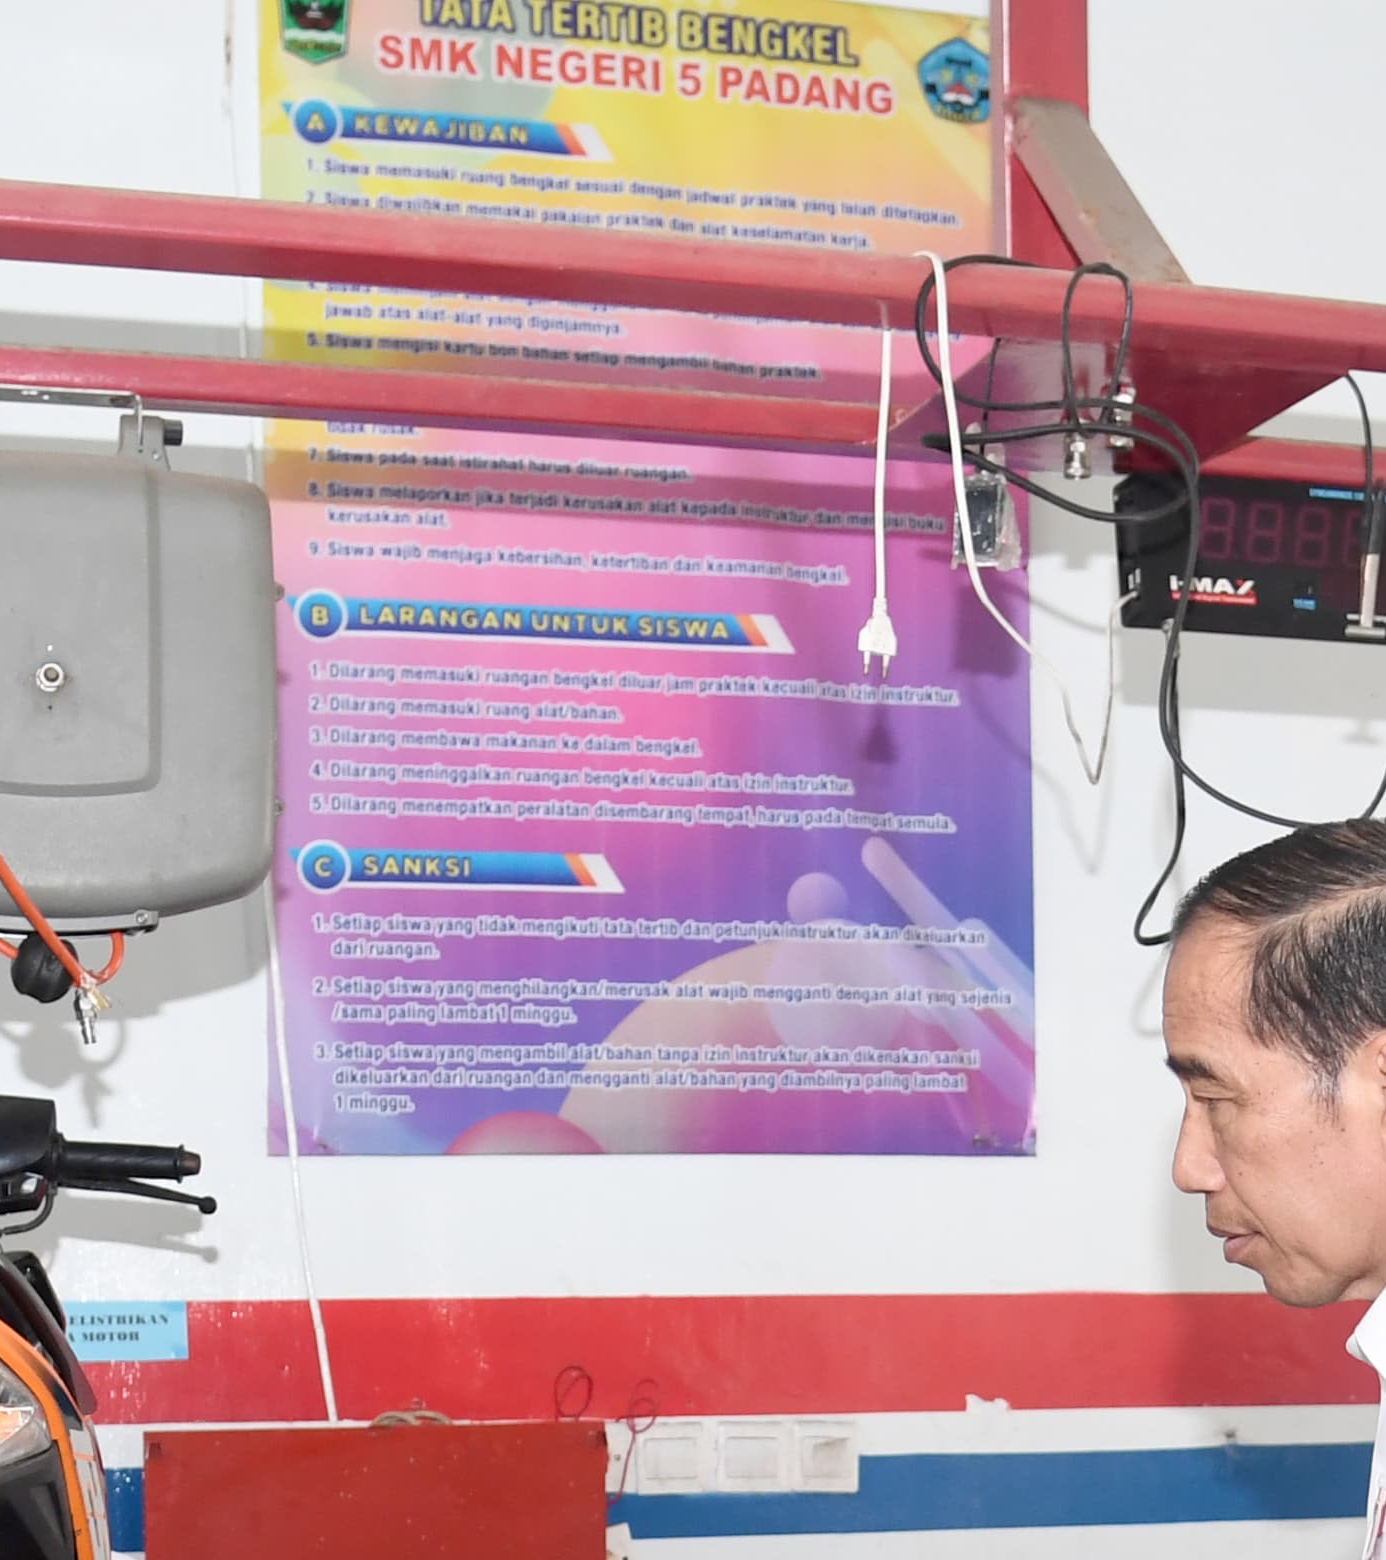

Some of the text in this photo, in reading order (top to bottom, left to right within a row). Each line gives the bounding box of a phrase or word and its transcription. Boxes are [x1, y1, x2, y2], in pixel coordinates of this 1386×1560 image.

[527, 0, 668, 47] TERTIB
[677, 10, 860, 66] BENGKEL
[379, 35, 893, 114] SMK NEGERI 5 PADANG
[307, 112, 325, 132] A
[354, 112, 530, 145] KEWAJIBAN
[310, 604, 330, 626] B
[359, 605, 731, 640] LARANGAN UNTUK SISWA
[329, 663, 395, 683] Dilarang
[402, 666, 480, 683] memasuki
[484, 672, 547, 689] ruangan
[553, 672, 613, 692] bengkel
[621, 675, 661, 690] diluar
[668, 677, 693, 695] jam
[699, 678, 755, 697] praktek
[762, 680, 814, 696] kecuali
[329, 696, 395, 716] Dilarang
[401, 698, 480, 715] memasuki
[485, 704, 529, 720] ruang
[329, 728, 395, 747] Dilarang
[402, 730, 480, 746] membawa
[487, 732, 555, 748] makanan
[561, 734, 579, 749] ke
[586, 735, 630, 750] dalam
[330, 762, 396, 781] Dilarang
[402, 764, 510, 784] meninggalkan
[517, 770, 579, 786] ruangan
[584, 769, 644, 788] bengkel
[648, 771, 702, 787] kecuali
[711, 773, 742, 788] atas
[745, 774, 770, 789] izin
[330, 796, 396, 815] Dilarang
[403, 798, 511, 819] menempatkan
[517, 801, 588, 821] peralatan
[595, 804, 692, 824] disembarang
[758, 809, 799, 824] harus
[806, 810, 841, 829] pada
[314, 856, 333, 878] C
[363, 856, 472, 878] SANKSI
[332, 914, 380, 933] Setiap
[387, 916, 430, 930] siswa
[437, 919, 472, 935] yang
[479, 918, 515, 932] tidak
[522, 918, 598, 938] mengikuti
[604, 920, 633, 935] tata
[639, 921, 678, 936] tertib
[683, 922, 710, 937] dan
[715, 923, 784, 942] petunjuk
[787, 924, 856, 940] instruktur
[863, 926, 901, 941] akan
[905, 927, 985, 942] dikeluarkan
[333, 940, 364, 954] dari
[333, 978, 381, 996] Setiap
[388, 979, 431, 994] siswa
[438, 983, 473, 998] yang
[480, 980, 669, 1001] menghilangkan/merusak
[676, 983, 703, 998] alat
[710, 984, 748, 1002] wajib
[753, 984, 831, 1003] mengganti
[838, 985, 888, 1004] dengan
[894, 986, 921, 1001] alat
[927, 990, 955, 1005] yang
[961, 987, 1011, 1005] sejenis
[388, 1004, 435, 1022] paling
[442, 1004, 494, 1019] lambat
[500, 1005, 507, 1019] 1
[513, 1005, 575, 1022] minggu.
[334, 1044, 382, 1062] Setiap
[389, 1044, 432, 1059] siswa
[439, 1048, 474, 1063] yang
[481, 1045, 564, 1063] mengambil
[571, 1046, 651, 1061] alat/bahan
[657, 1047, 698, 1065] tanpa
[704, 1047, 730, 1061] izin
[735, 1047, 807, 1062] instruktur
[814, 1048, 848, 1063] akan
[853, 1049, 927, 1063] dikenakan
[934, 1049, 977, 1064] sanksi
[335, 1070, 963, 1091] dikeluarkan dari ruangan dan mengganti alat/bahan yang diambilnya paling lambat
[69, 1314, 171, 1326] ELISTRIKAN
